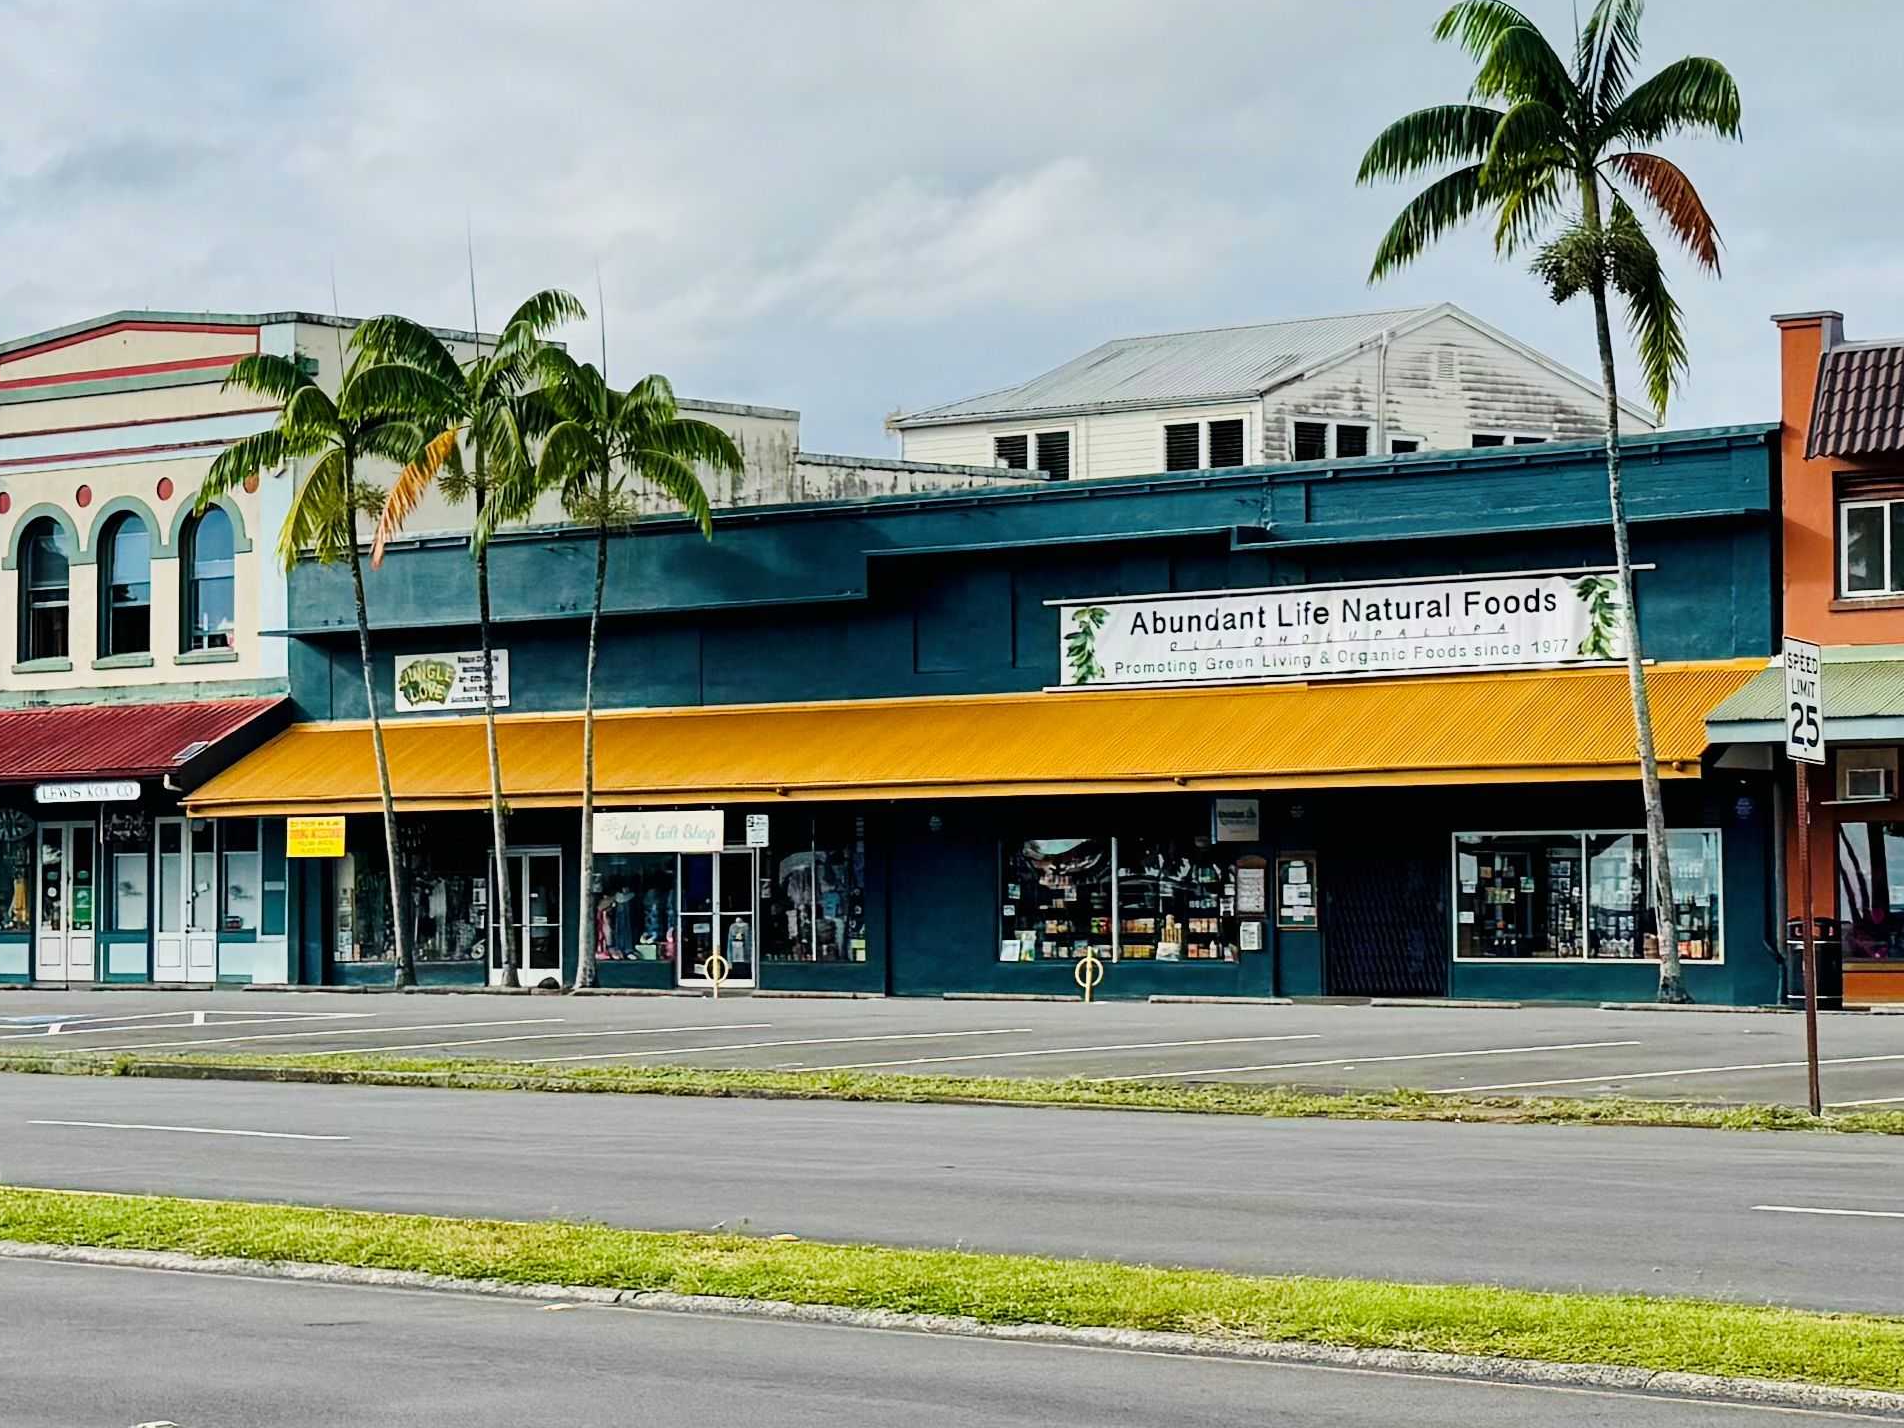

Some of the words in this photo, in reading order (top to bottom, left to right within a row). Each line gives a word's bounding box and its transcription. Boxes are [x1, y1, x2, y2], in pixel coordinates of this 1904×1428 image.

[1130, 606, 1266, 635] Abundant
[1278, 602, 1329, 627] Life
[1342, 592, 1450, 623] Natural
[1464, 588, 1557, 616] Foods
[1115, 659, 1197, 675] Promoting
[1206, 657, 1253, 670] Green
[1262, 652, 1311, 668] Living
[1320, 651, 1331, 664] &
[1338, 648, 1405, 665] Organic
[1414, 644, 1467, 659] Foods
[1474, 641, 1521, 656] since
[1530, 638, 1569, 654] 1977
[1787, 652, 1818, 674] SPEED
[400, 664, 454, 686] JUNGLE
[410, 682, 446, 701] LOVE
[1791, 678, 1815, 698] LIMIT
[1791, 701, 1819, 748] 25
[43, 786, 81, 800] LEWIS
